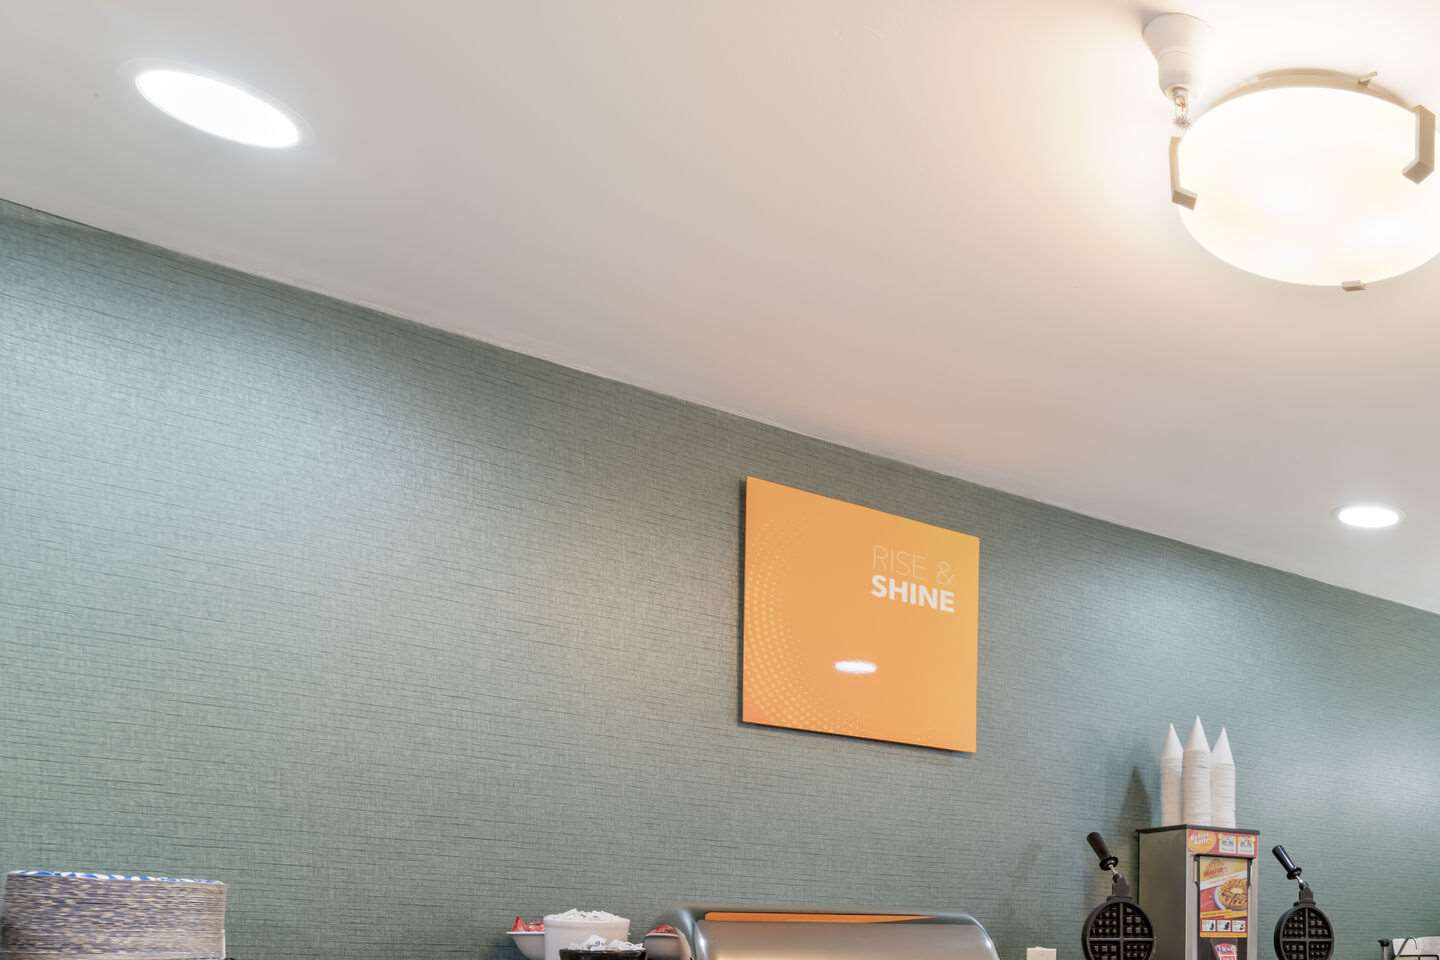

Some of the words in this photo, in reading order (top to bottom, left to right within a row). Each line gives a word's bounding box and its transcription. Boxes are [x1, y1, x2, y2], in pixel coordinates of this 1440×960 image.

[873, 545, 928, 577] RISE
[937, 561, 956, 585] &
[872, 575, 955, 612] SHINE
